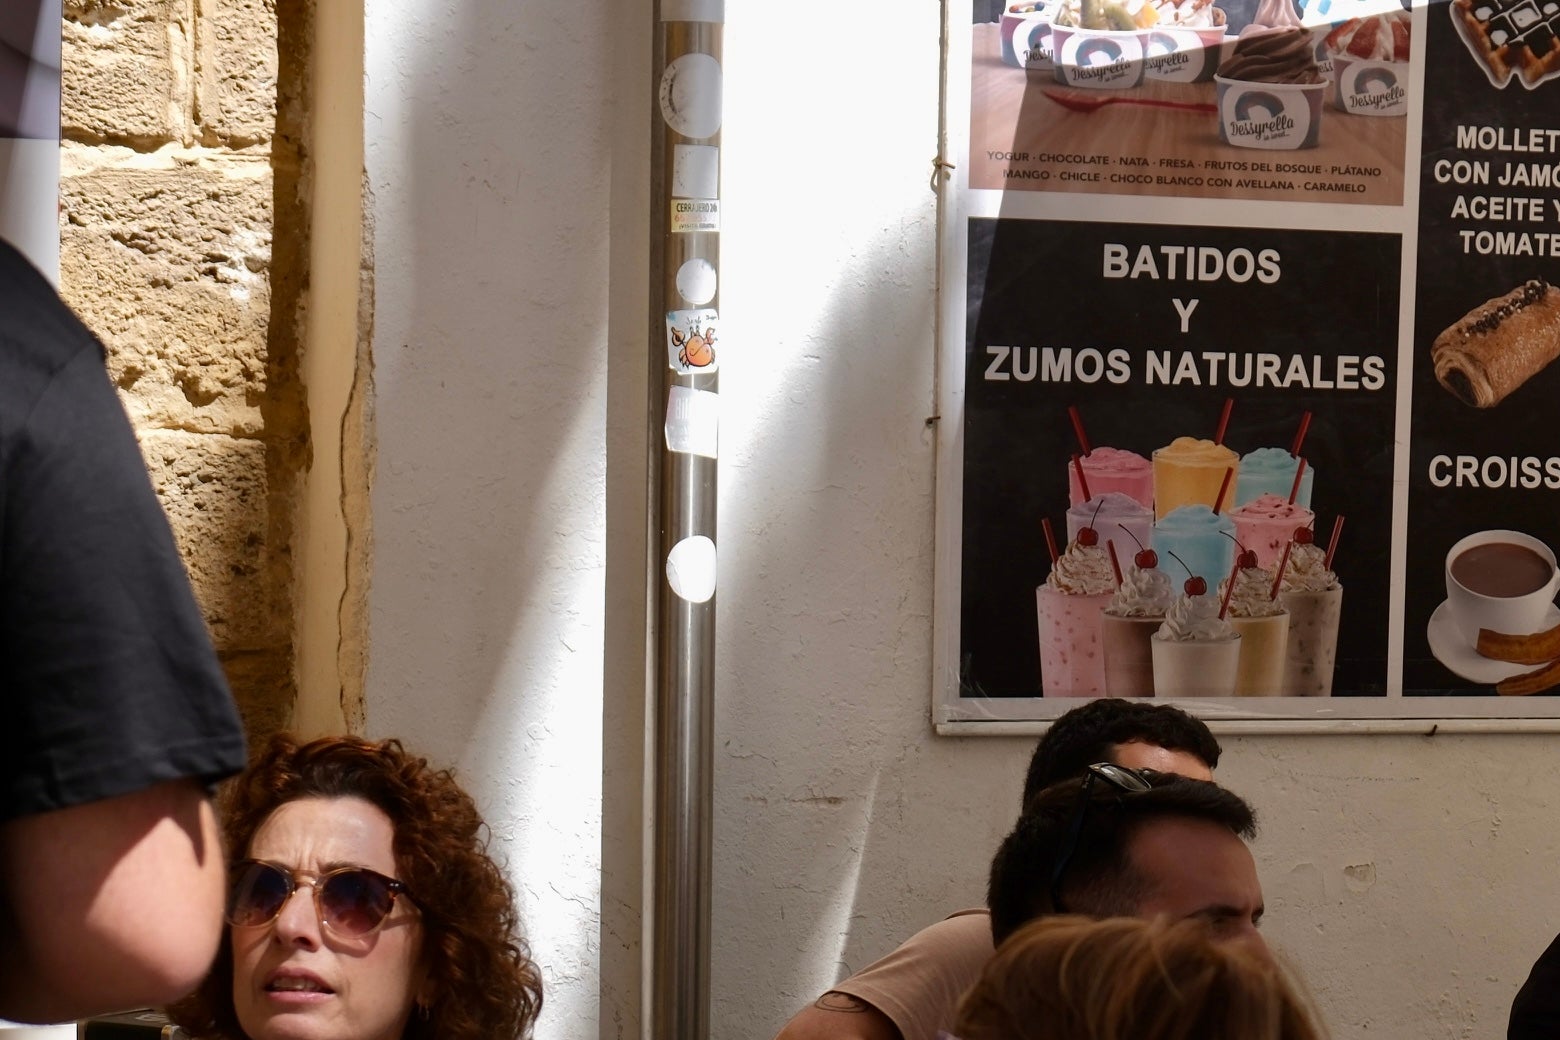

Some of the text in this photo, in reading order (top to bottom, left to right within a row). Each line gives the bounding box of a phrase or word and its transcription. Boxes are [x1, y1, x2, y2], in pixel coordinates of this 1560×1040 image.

[1071, 56, 1132, 81] Dessyrella
[1143, 52, 1190, 75] essyrella
[1349, 86, 1406, 110] Dessyrella
[1230, 114, 1294, 141] Dessyrella
[986, 151, 1382, 177] YOGUR CHOCOLATE NATA FRESA FRUTOS DEL BOSQUE PLÁTANO
[1434, 159, 1491, 185] CON
[1002, 169, 1367, 193] MANGO CHICLE CHOCO BLANCO CON AVELLANA CARAMELO
[1451, 196, 1544, 222] ACEITE
[1102, 243, 1282, 285] BATIDOS
[1172, 298, 1200, 333] Y
[984, 345, 1386, 391] ZUMOS NATURALES
